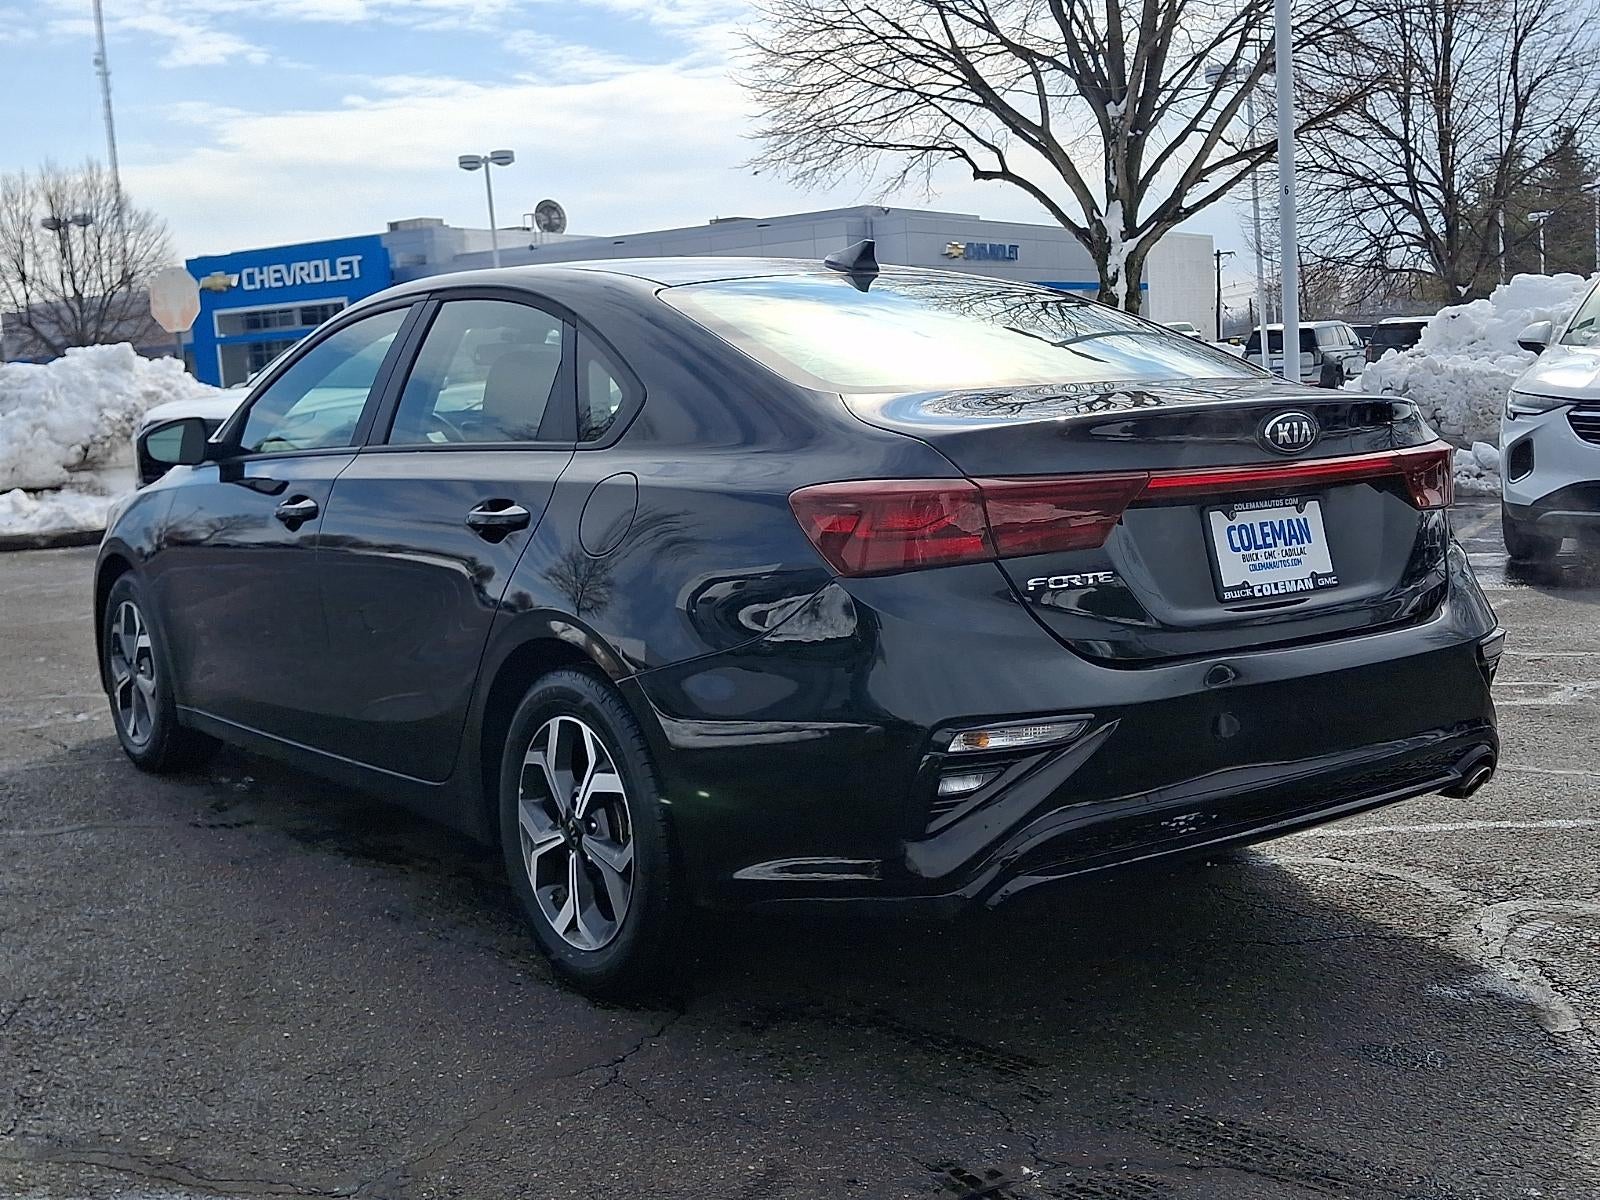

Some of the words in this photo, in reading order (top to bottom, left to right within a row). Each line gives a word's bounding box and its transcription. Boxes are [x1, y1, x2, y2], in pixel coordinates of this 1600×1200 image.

[1284, 184, 1290, 196] 6
[241, 254, 363, 291] CHEVROLET
[1276, 421, 1311, 445] KIA
[1233, 498, 1299, 511] COLEMANAUTOSCOM
[1226, 517, 1312, 553] COLEMAN
[1241, 553, 1260, 563] BUICK
[1263, 551, 1276, 561] GMC
[1280, 547, 1307, 558] CADILLAC
[1248, 557, 1303, 573] COLEMANAUTOS.COM
[1027, 571, 1114, 591] FORTE
[1223, 588, 1253, 600] BUICK
[1253, 577, 1314, 598] COLEMAN
[1317, 576, 1338, 586] GMC
